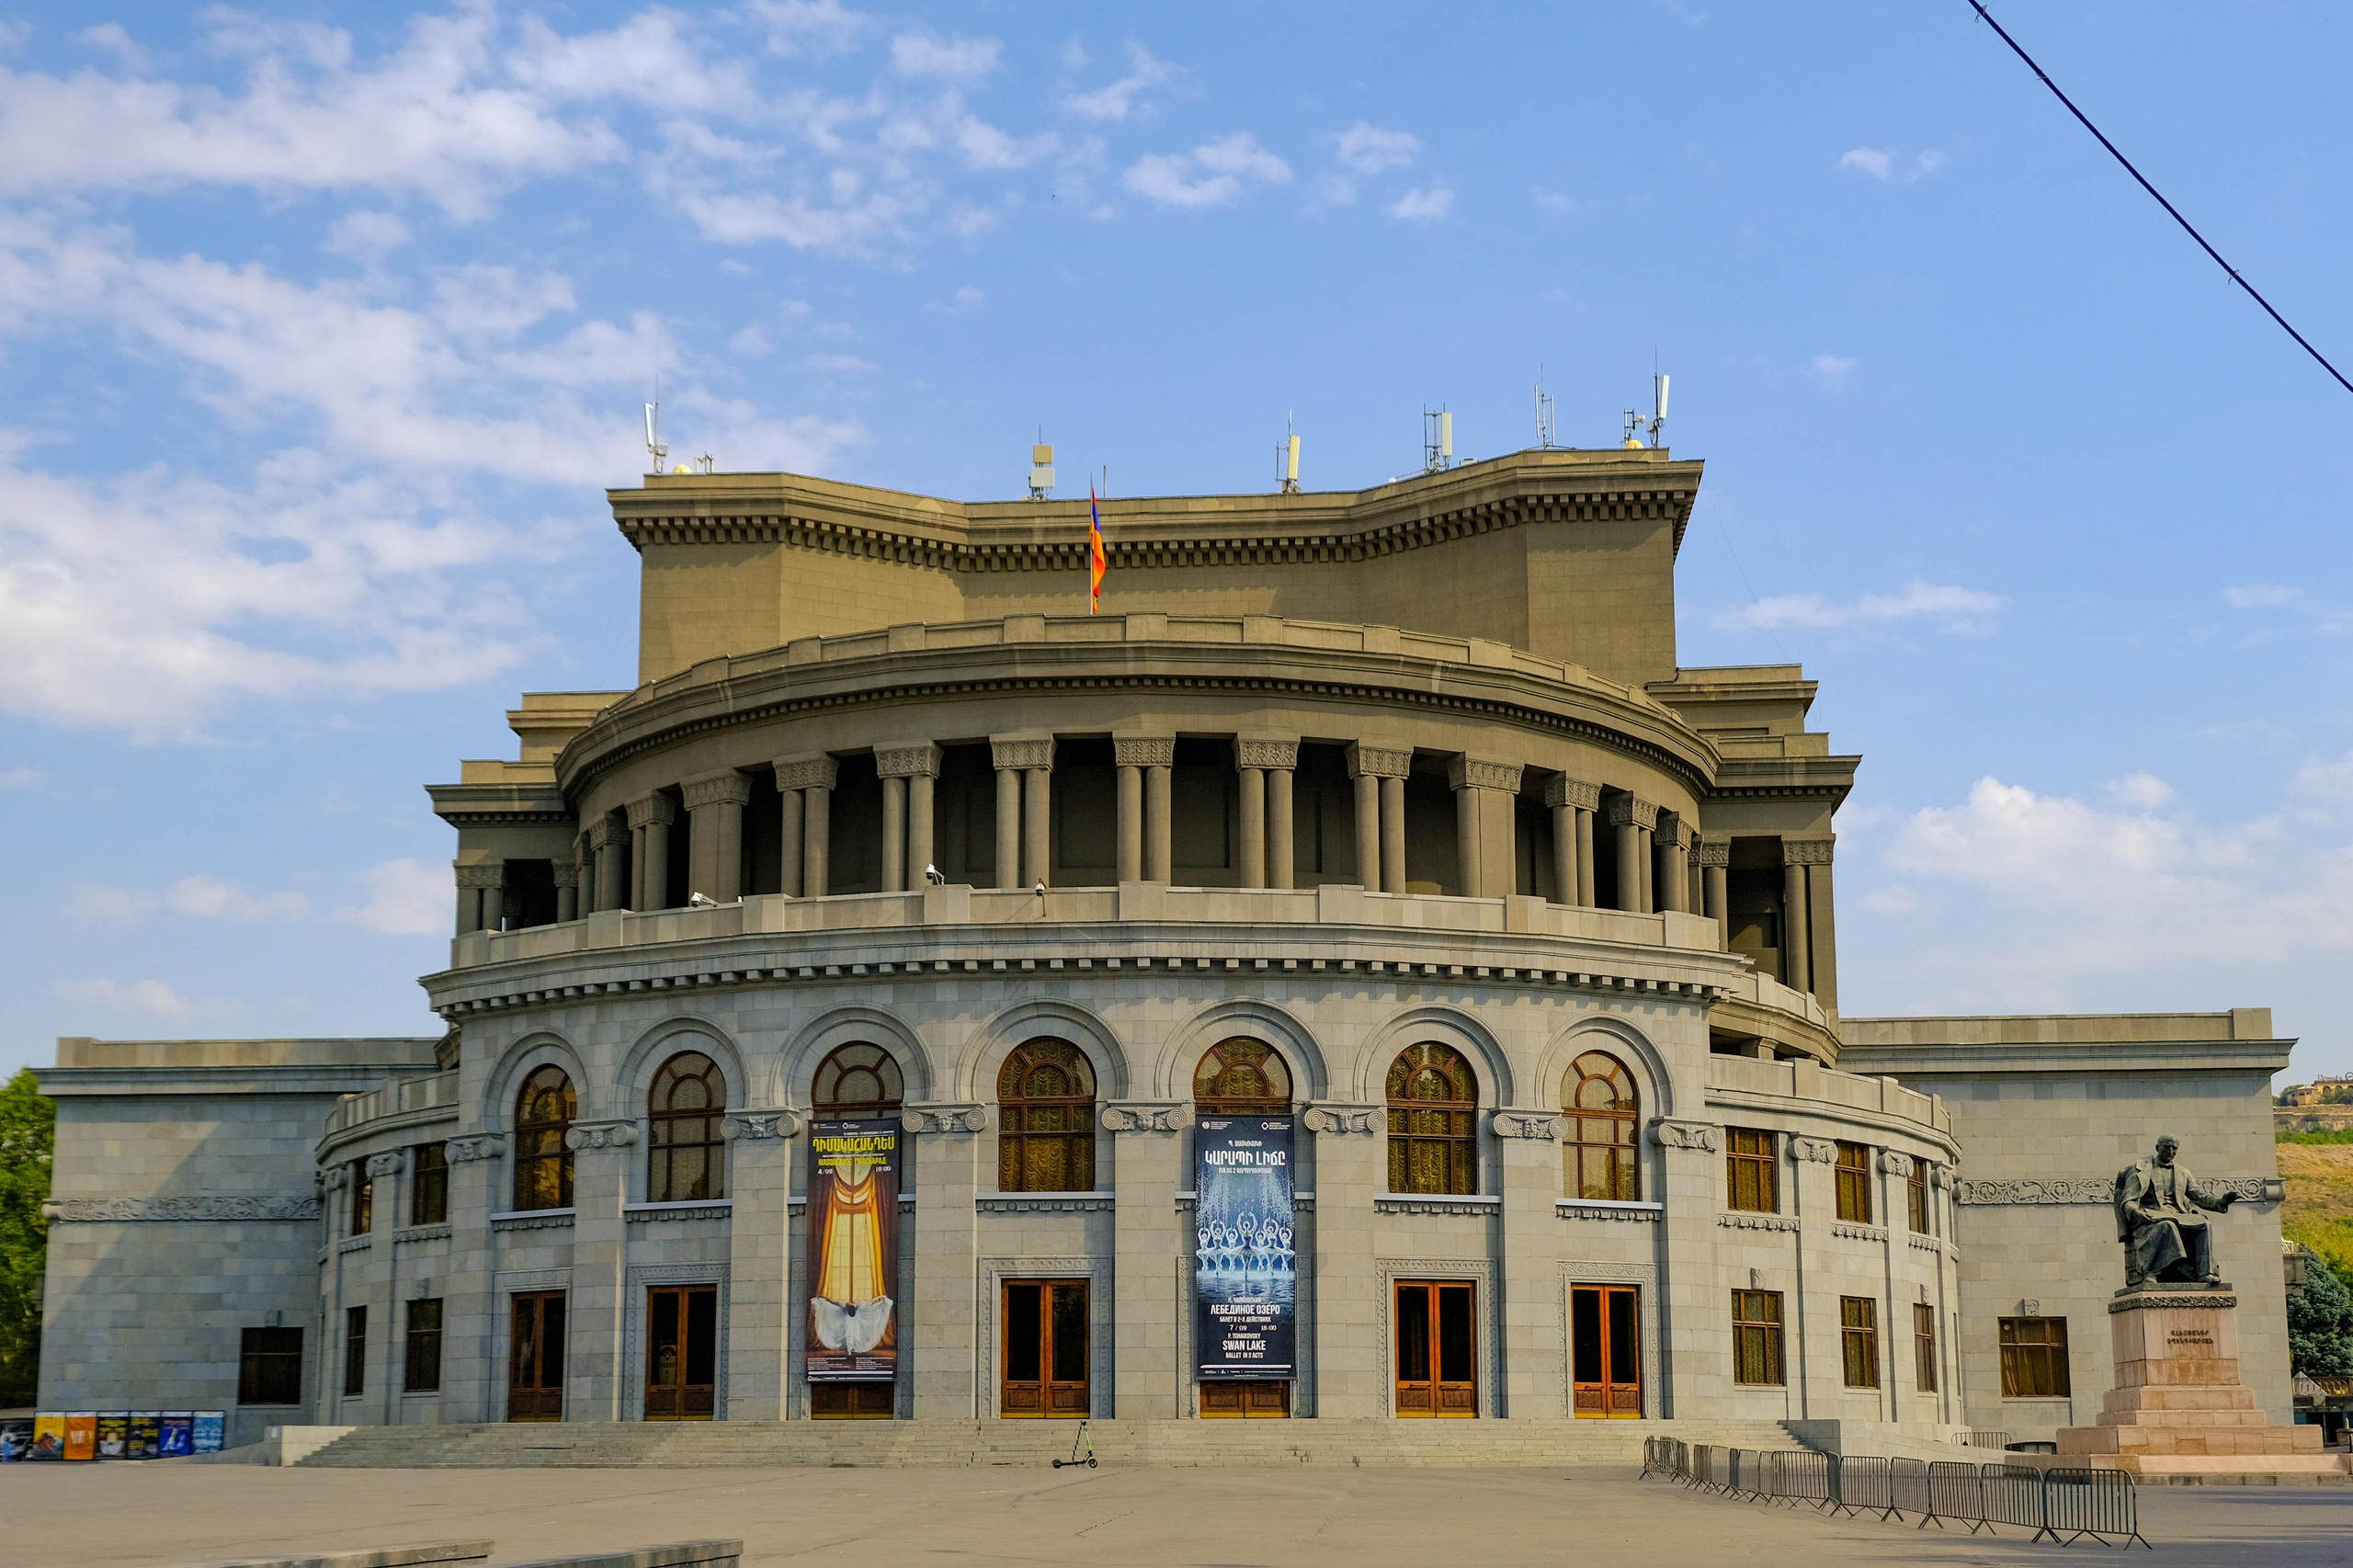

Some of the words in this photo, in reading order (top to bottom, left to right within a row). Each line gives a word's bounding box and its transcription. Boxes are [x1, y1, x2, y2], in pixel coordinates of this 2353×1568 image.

[813, 1136, 895, 1153] ԴԻՄԱԿԱՀԱՆԴԵՍ
[1205, 1150, 1254, 1165] ԿԱՐԱՊԻ
[1256, 1150, 1286, 1165] ԼԻՃԸ
[1211, 1304, 1256, 1314] ЛЕБЕДИНОЕ
[1256, 1304, 1280, 1314] ОЗЕРО
[1222, 1339, 1245, 1351] SWAN
[1246, 1339, 1267, 1351] LAKE
